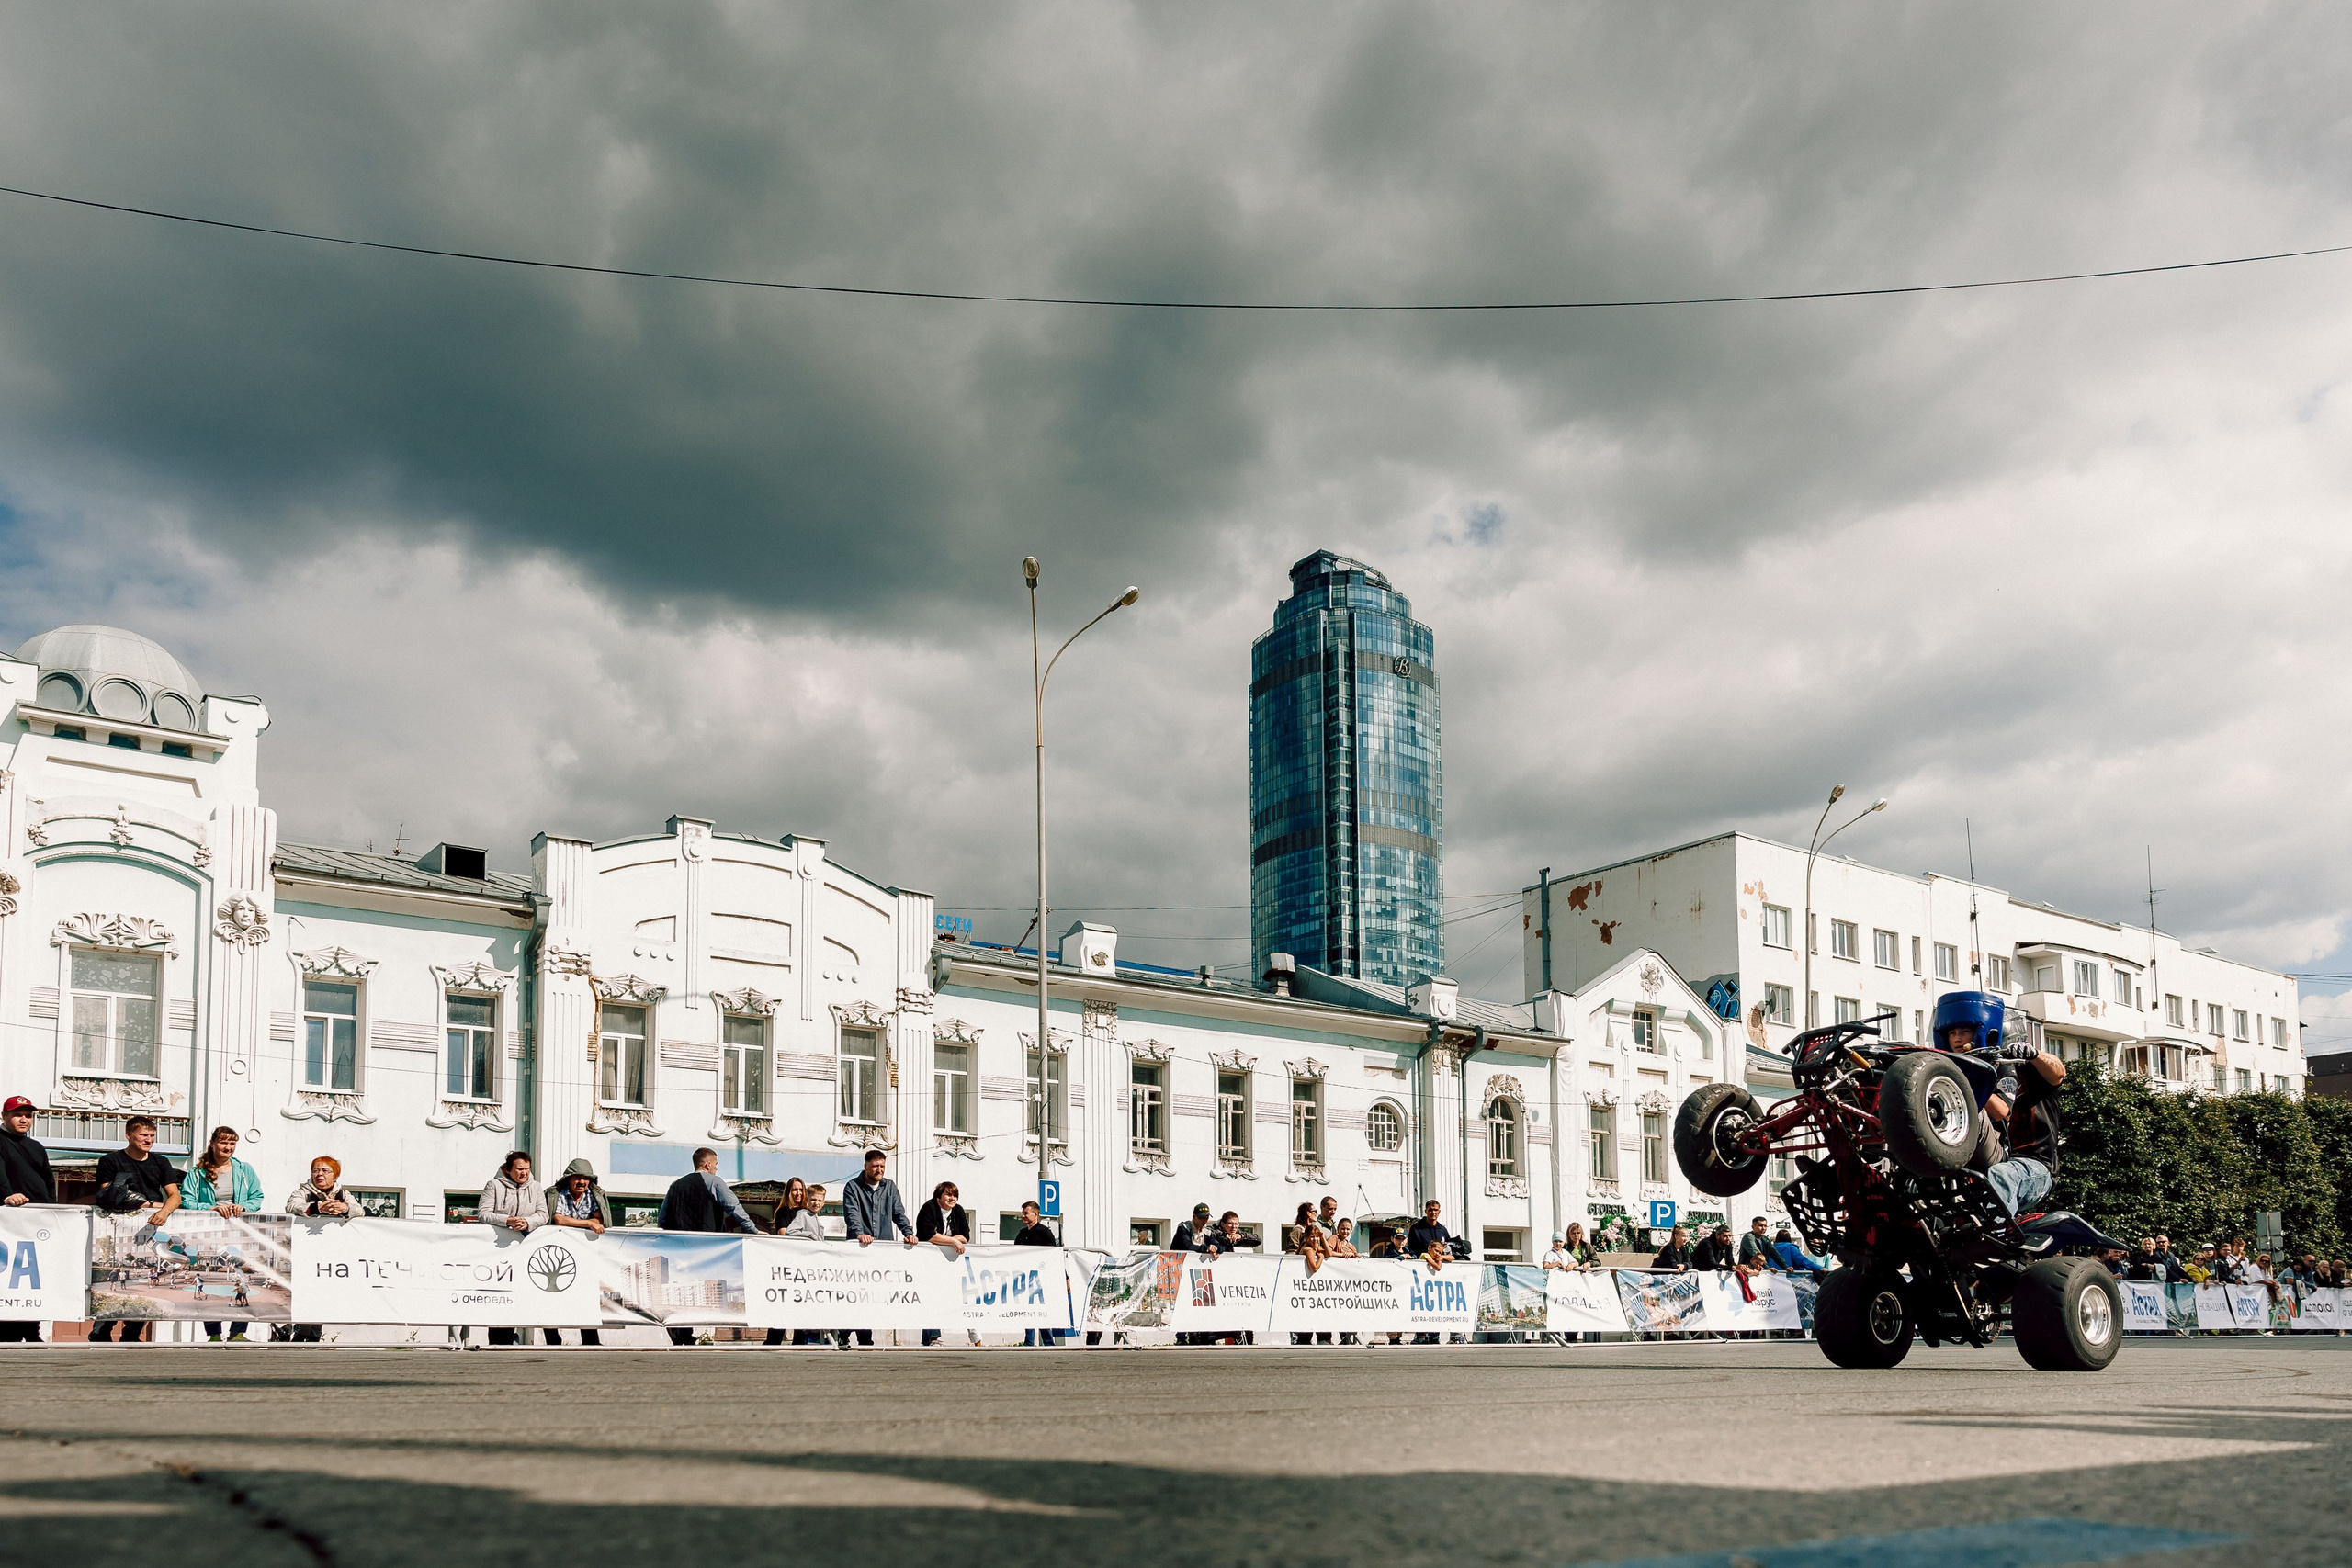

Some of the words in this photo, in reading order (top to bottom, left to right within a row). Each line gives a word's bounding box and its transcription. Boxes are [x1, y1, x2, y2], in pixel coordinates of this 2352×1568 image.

[935, 914, 973, 933] СЕТИ
[1045, 1183, 1057, 1213] P
[1588, 1202, 1627, 1215] GEORGIA
[1657, 1203, 1672, 1225] P
[316, 1262, 350, 1279] на
[771, 1266, 913, 1284] НЕДВИЖИМОСТЬ
[961, 1256, 1046, 1305] АСТРА
[1293, 1279, 1393, 1292] НЕДВИЖИМОСТЬ
[462, 1294, 514, 1305] очередь
[764, 1287, 788, 1303] ОТ
[793, 1287, 922, 1306] ЗАСТРОЙЩИКА
[1219, 1285, 1267, 1299] VENEZIA
[1410, 1269, 1467, 1312] АСТРА
[1290, 1296, 1306, 1309] ОТ
[1308, 1295, 1399, 1311] ЗАСТРОЙЩИКА
